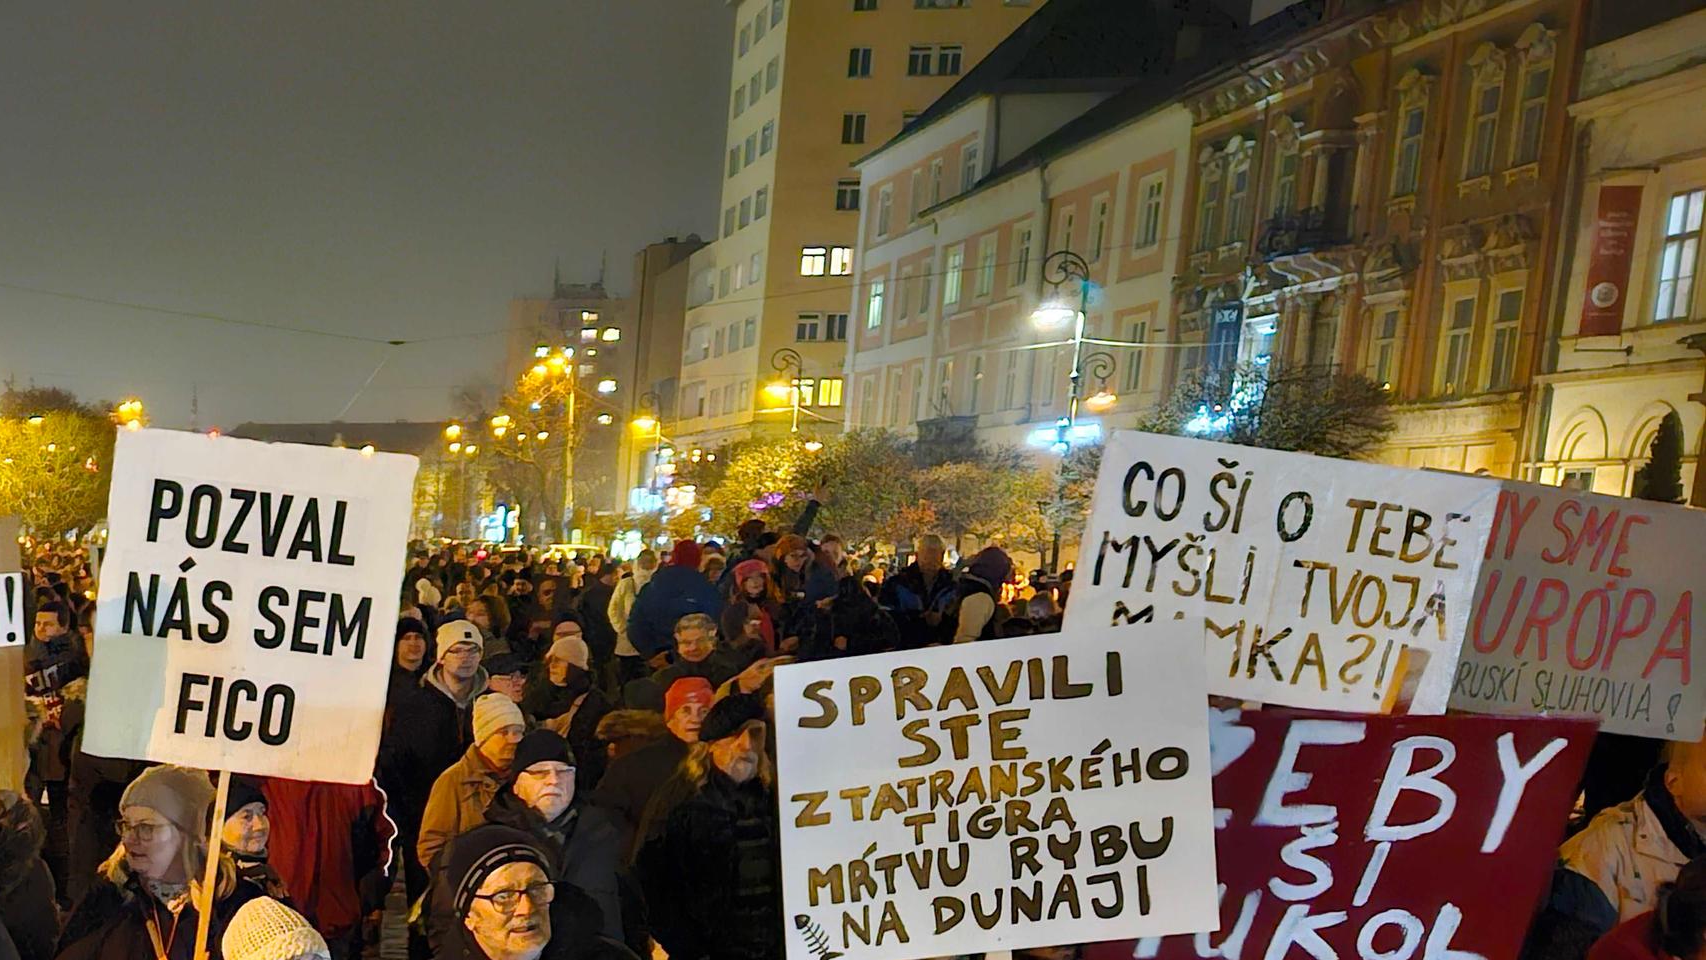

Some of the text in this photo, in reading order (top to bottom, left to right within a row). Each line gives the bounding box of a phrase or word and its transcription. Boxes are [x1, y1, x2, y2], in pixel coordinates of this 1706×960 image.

[146, 478, 356, 566] POZVAL
[1122, 460, 1187, 522] CO
[1277, 490, 1314, 543] O
[1346, 498, 1472, 570] TEBE
[1541, 499, 1652, 578] SME
[121, 556, 373, 660] NÁS SEM
[1292, 558, 1447, 642] TVOJA
[1471, 570, 1694, 686] URÓPA
[797, 651, 1124, 729] SPRAVILI
[1110, 600, 1393, 700] MKA?!
[174, 672, 296, 746] FICO
[897, 708, 1032, 769] STE
[1531, 669, 1652, 723] SLUHOVIA
[790, 738, 1189, 828] Z TATRANSKÉHO
[903, 796, 1078, 846] TIGRA
[807, 816, 1174, 907] MŔTVU RYBU
[1267, 822, 1393, 907] ŠI
[841, 864, 1151, 949] NA DUNAJI
